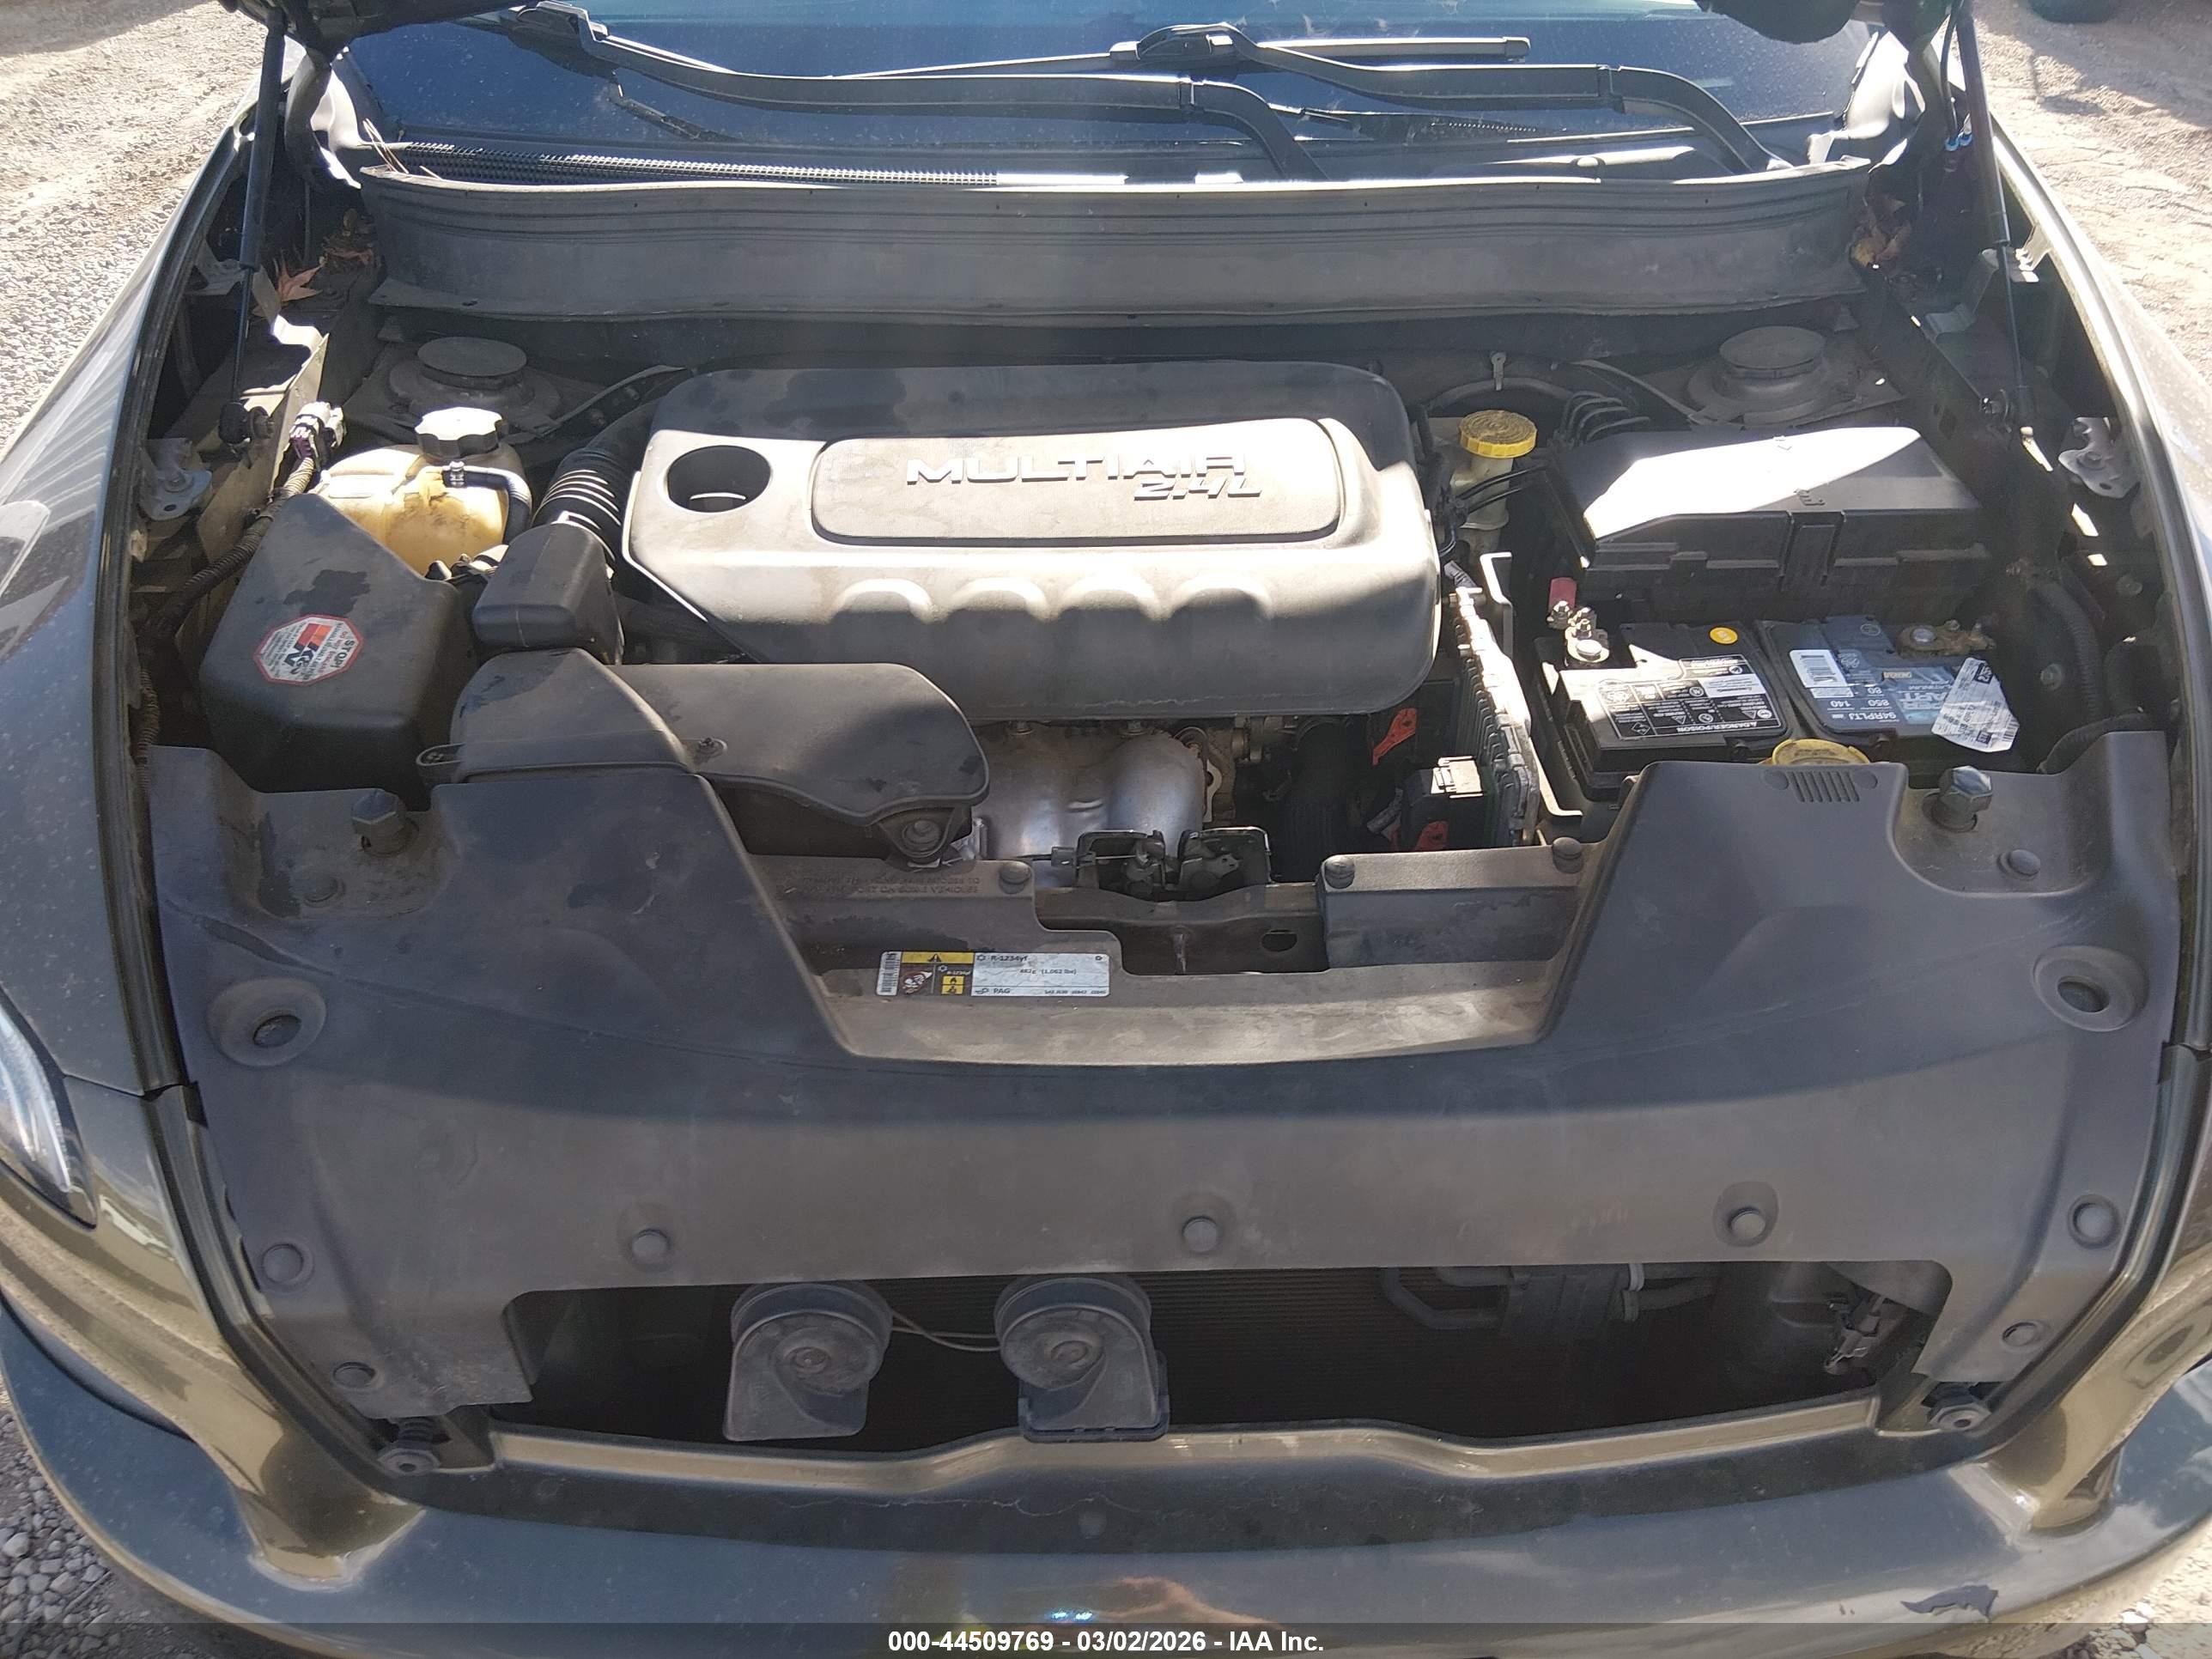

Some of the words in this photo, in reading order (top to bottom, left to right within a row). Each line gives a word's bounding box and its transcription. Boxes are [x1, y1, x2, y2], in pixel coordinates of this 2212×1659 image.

[907, 453, 1245, 485] MULTIAIR
[1133, 477, 1261, 501] 2.4L
[330, 640, 355, 667] STOP!
[1899, 692, 1947, 702] ART
[1903, 702, 1942, 710] PER
